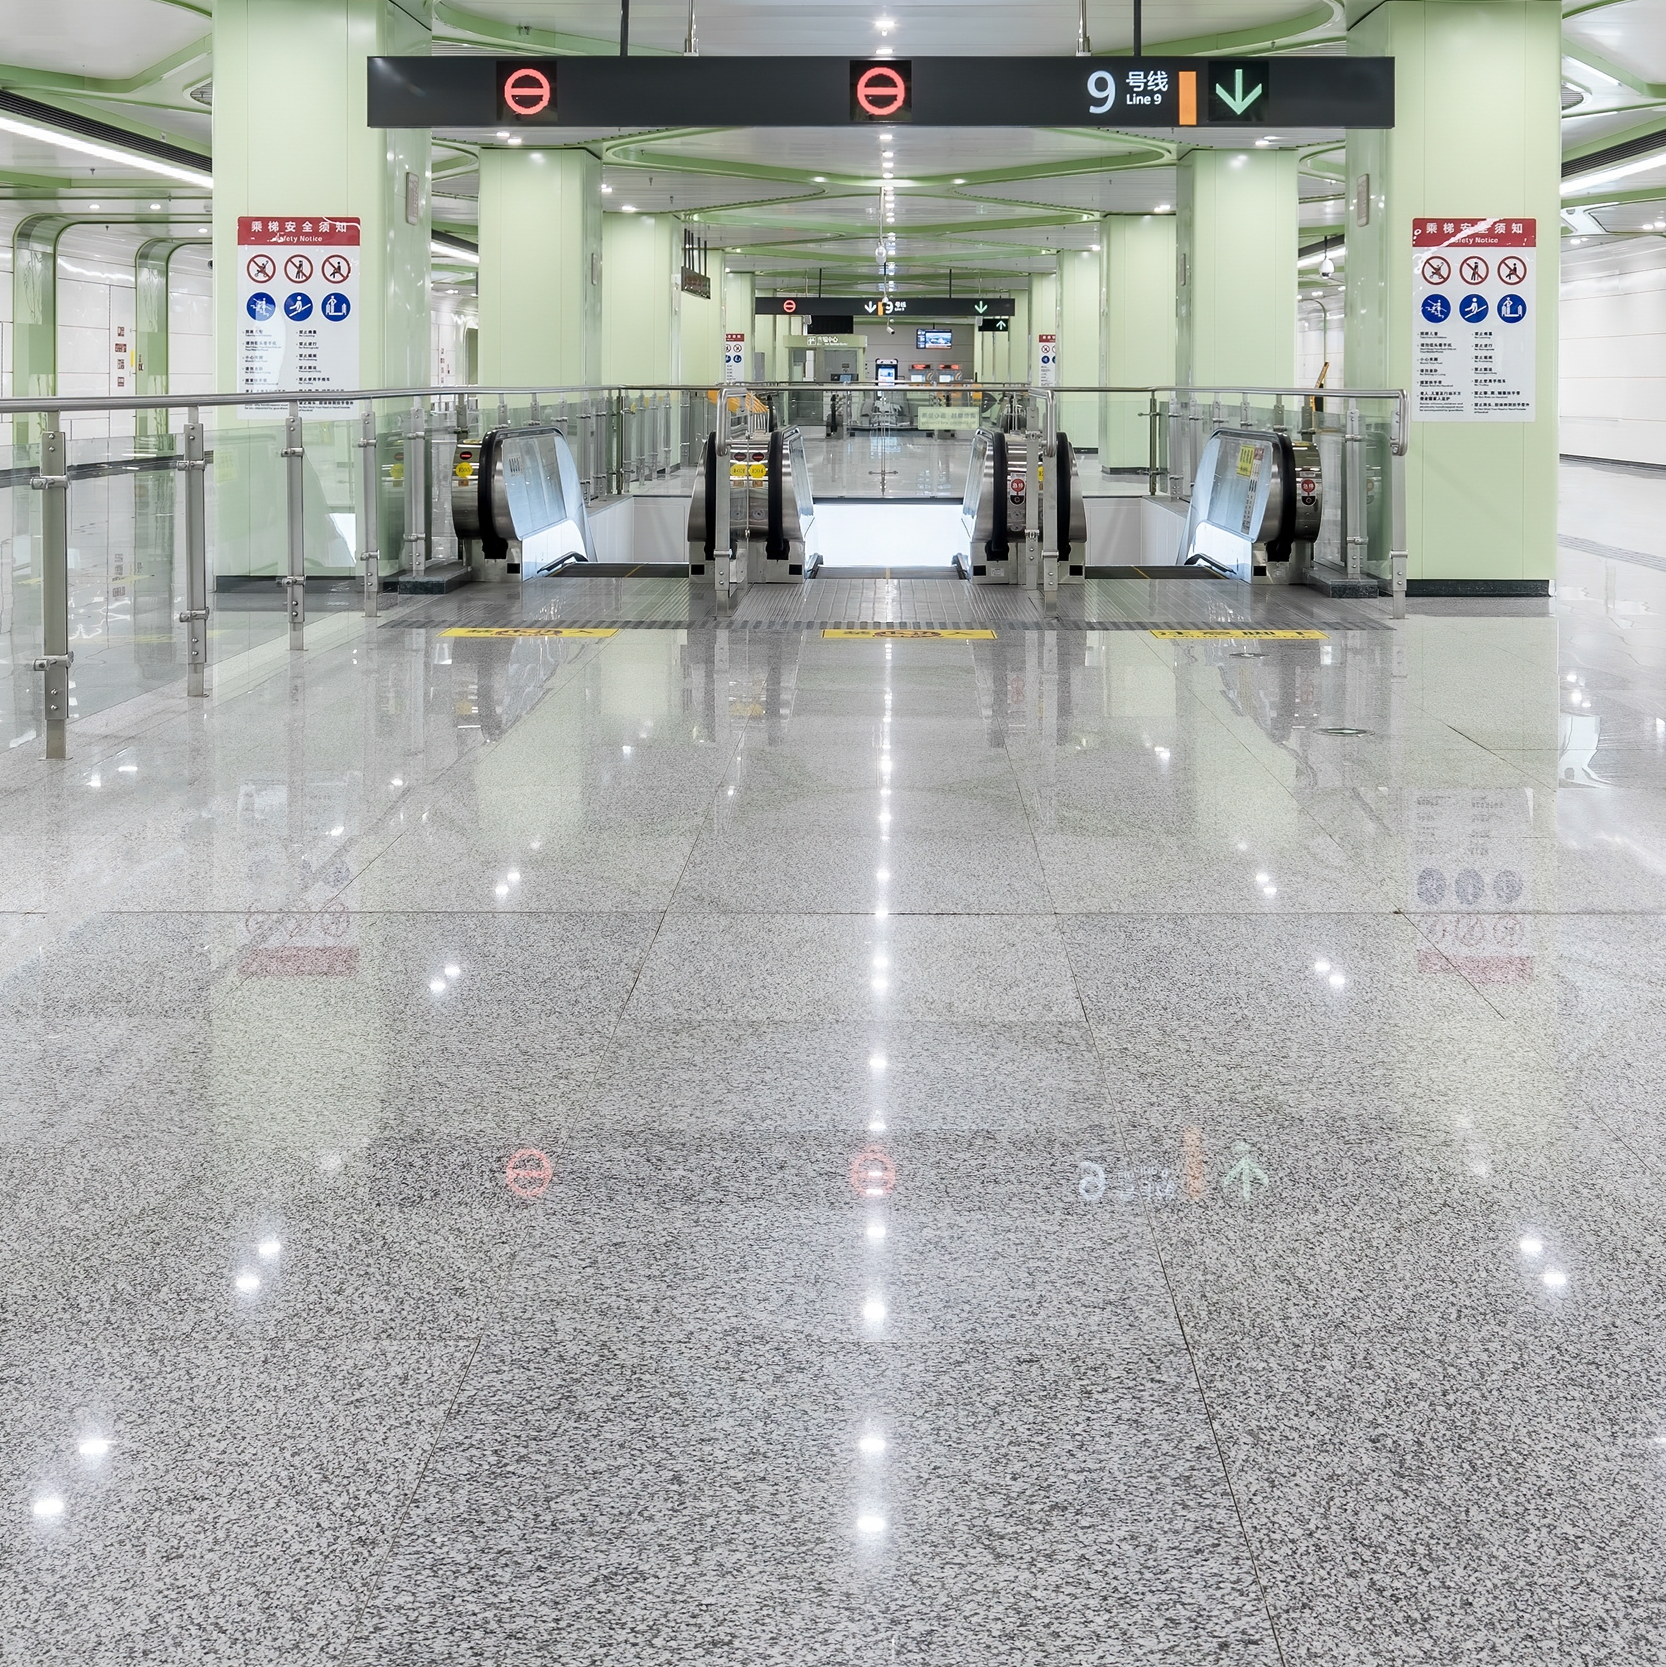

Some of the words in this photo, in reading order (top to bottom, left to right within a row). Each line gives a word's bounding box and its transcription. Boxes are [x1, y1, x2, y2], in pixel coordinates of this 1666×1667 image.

[1087, 70, 1116, 114] 9
[1125, 70, 1169, 92] 号线
[1126, 93, 1152, 105] Line
[1153, 93, 1162, 105] 9
[251, 220, 347, 233] 乘梯安全须知
